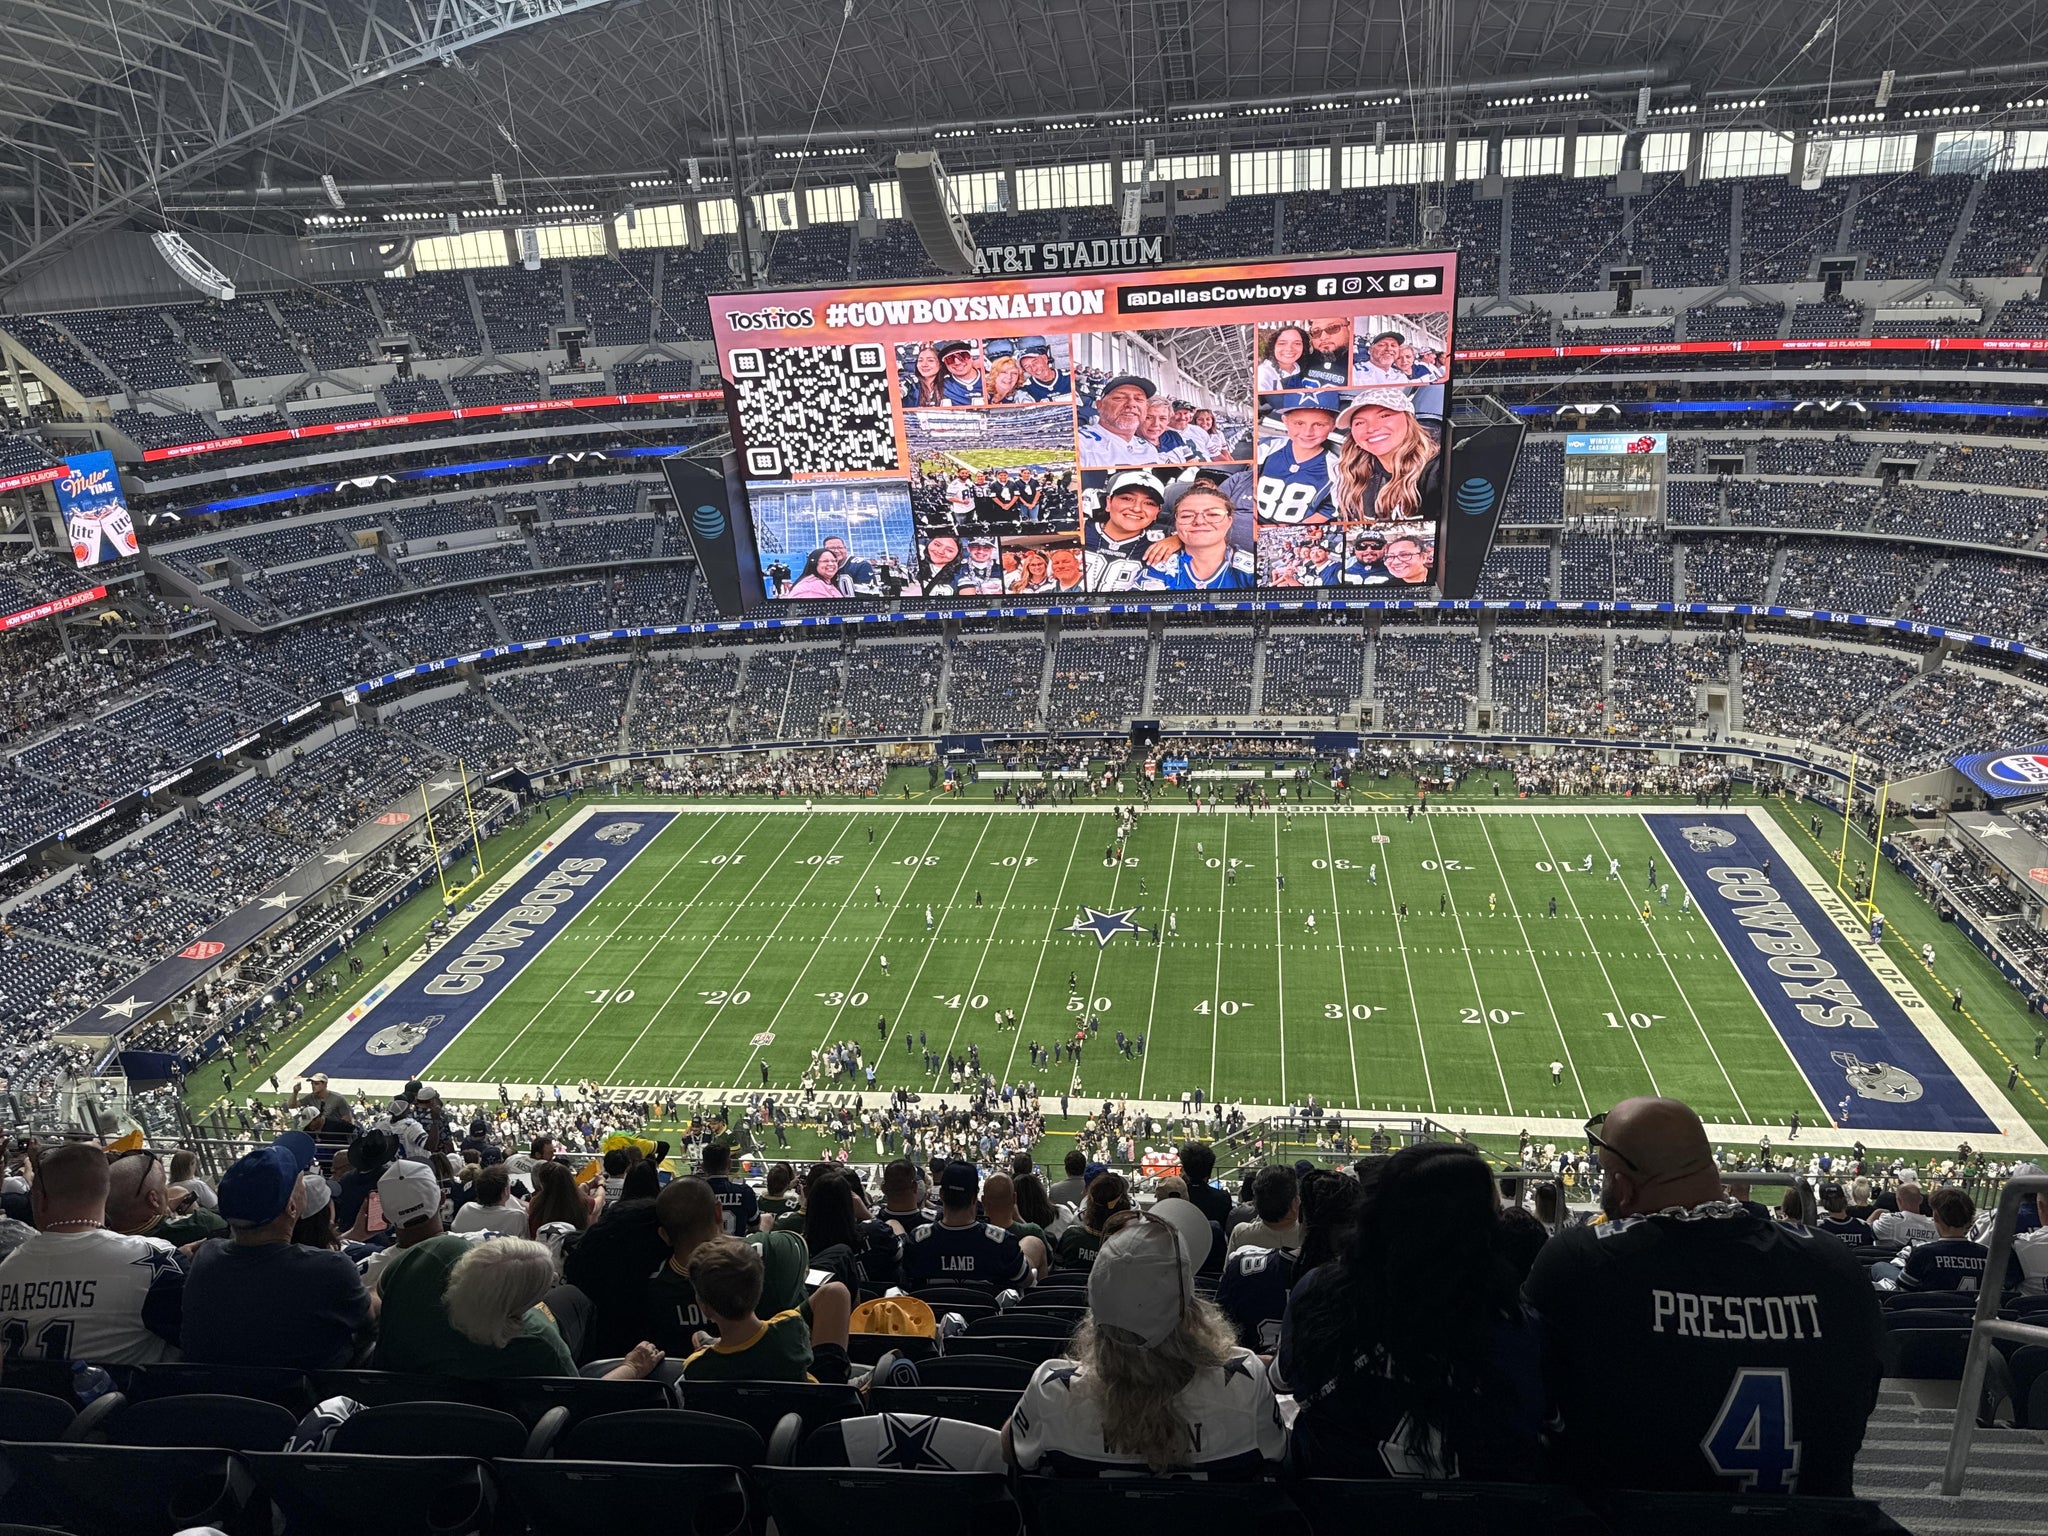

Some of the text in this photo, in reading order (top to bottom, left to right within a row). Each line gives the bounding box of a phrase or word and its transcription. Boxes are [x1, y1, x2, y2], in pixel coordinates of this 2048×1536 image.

[973, 235, 1163, 274] AT&T STADIUM
[1126, 282, 1307, 307] @DallasCowboys
[825, 289, 1105, 328] #COWBOYSNATION
[1477, 350, 1505, 358] FLAVORS
[1651, 344, 1682, 352] FLAVORS
[381, 417, 409, 426] FLAVORS
[215, 438, 243, 448] FLAVORS
[21, 476, 31, 485] 23
[31, 469, 59, 483] FLAVORS
[61, 468, 110, 499] Miller
[89, 481, 116, 497] TIME
[70, 523, 95, 540] Lite
[110, 513, 132, 536] Lite
[5, 615, 21, 628] HOW
[36, 605, 53, 618] THEM
[53, 600, 64, 611] 23
[63, 590, 95, 608] FLAVORS
[287, 700, 322, 722] Blockchain.com
[222, 731, 261, 757] Blockchain.com
[149, 766, 194, 795] Blockchain.com
[65, 806, 116, 838] Blockchain.com
[711, 854, 747, 865] 10
[806, 855, 844, 866] 20
[903, 855, 940, 866] 30
[1002, 856, 1038, 867] 40
[1102, 857, 1140, 868] 50
[1205, 857, 1243, 869] 40
[1311, 859, 1350, 870] 30
[1421, 859, 1463, 871] 20
[1535, 861, 1576, 873] 10
[473, 882, 511, 913] CATCH
[423, 857, 607, 995] COWBOYS
[1706, 866, 1880, 1029] COWBOYS
[1806, 882, 1924, 1009] IT TAKES ALL OF US
[590, 989, 635, 1004] 10
[704, 990, 751, 1005] 20
[823, 991, 869, 1007] 30
[943, 993, 989, 1009] 40
[1066, 996, 1112, 1012] 50
[1193, 999, 1239, 1016] 40
[1324, 1003, 1372, 1020] 30
[1459, 1007, 1509, 1024] 20
[1602, 1011, 1652, 1029] 10
[599, 1088, 703, 1105] CANCER
[1906, 1228, 1936, 1239] AUBREY
[941, 1255, 975, 1271] LAMB
[0, 1280, 97, 1312] PARSONS
[1652, 1288, 1822, 1340] PRESCOTT
[1699, 1366, 1803, 1494] 4
